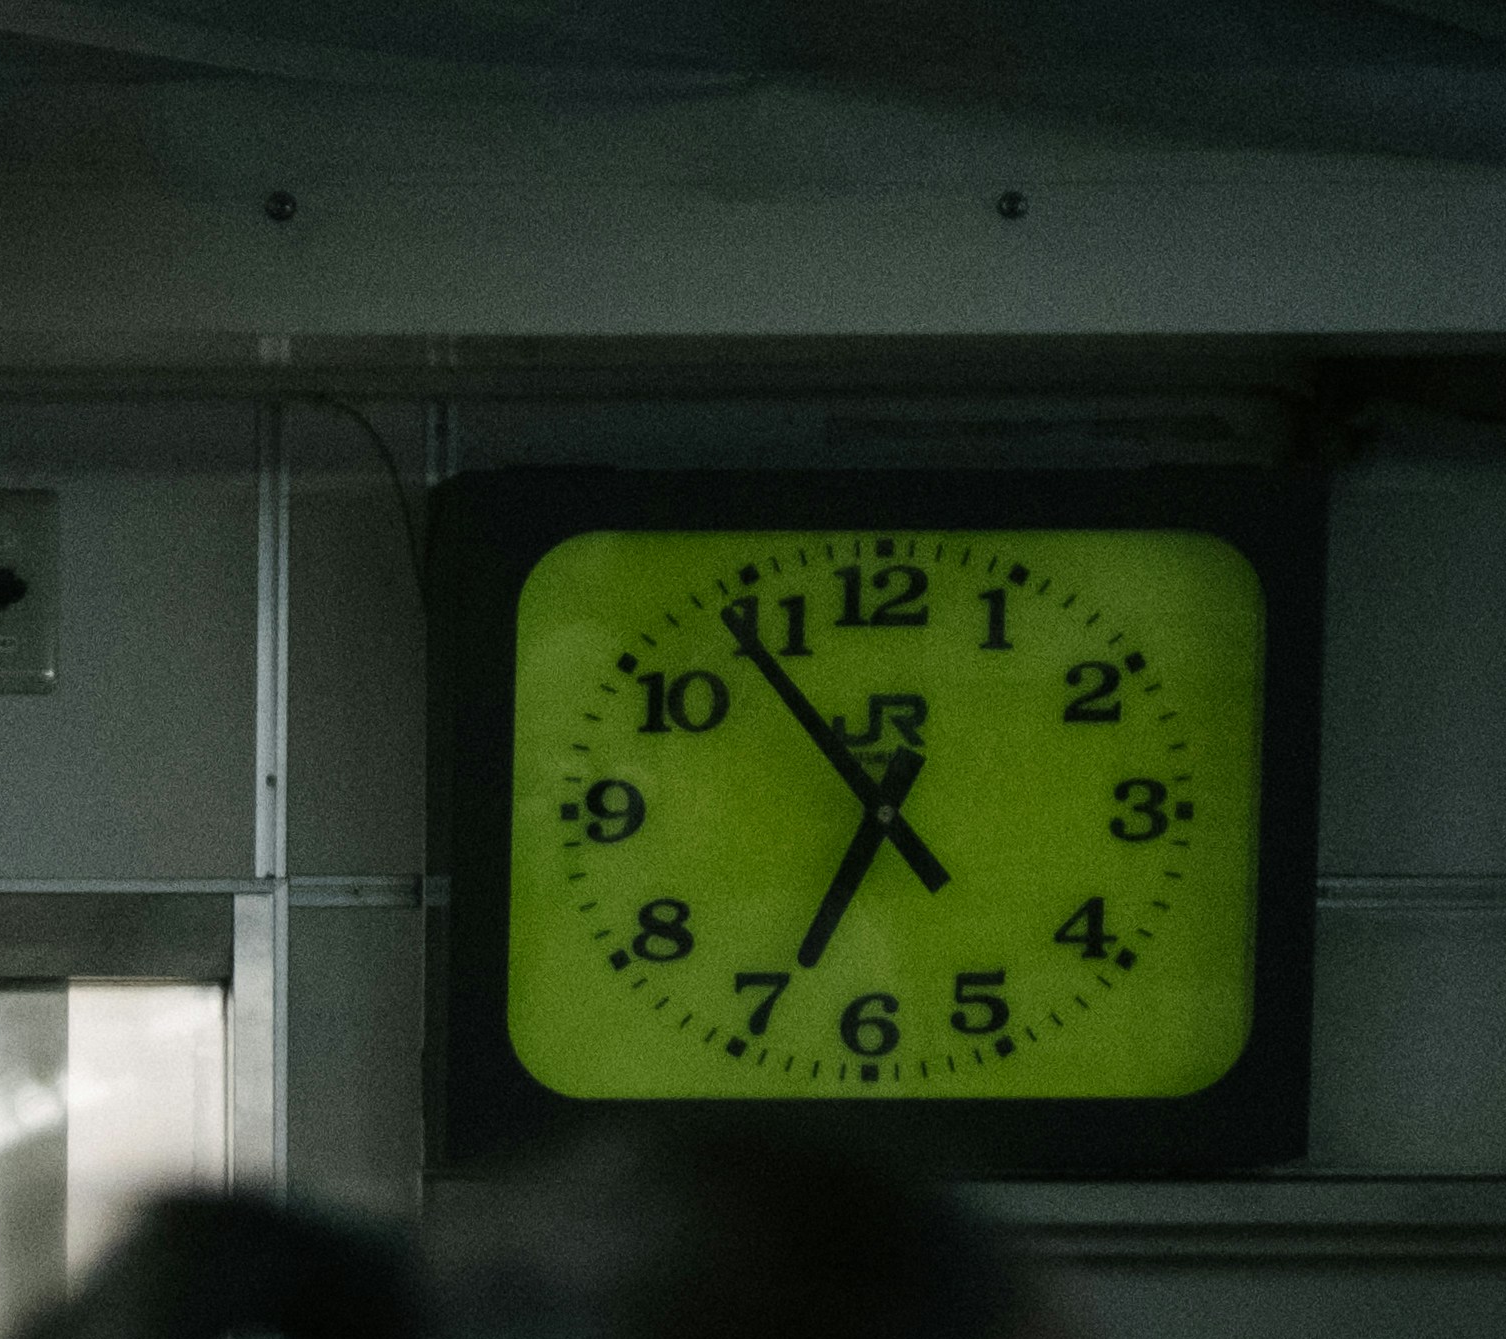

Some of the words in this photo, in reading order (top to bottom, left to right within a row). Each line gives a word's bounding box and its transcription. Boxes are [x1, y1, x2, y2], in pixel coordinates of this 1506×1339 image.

[730, 594, 813, 658] 11
[834, 565, 930, 628] 12
[978, 588, 1013, 650] 1
[637, 670, 729, 734] 10
[833, 694, 928, 746] JR
[1063, 661, 1122, 723] 2
[584, 779, 647, 844] 9
[1109, 779, 1169, 842] 3
[632, 899, 696, 962] 8
[1054, 897, 1118, 959] 4
[734, 972, 791, 1036] 7
[839, 993, 900, 1056] 6
[949, 971, 1010, 1034] 5
